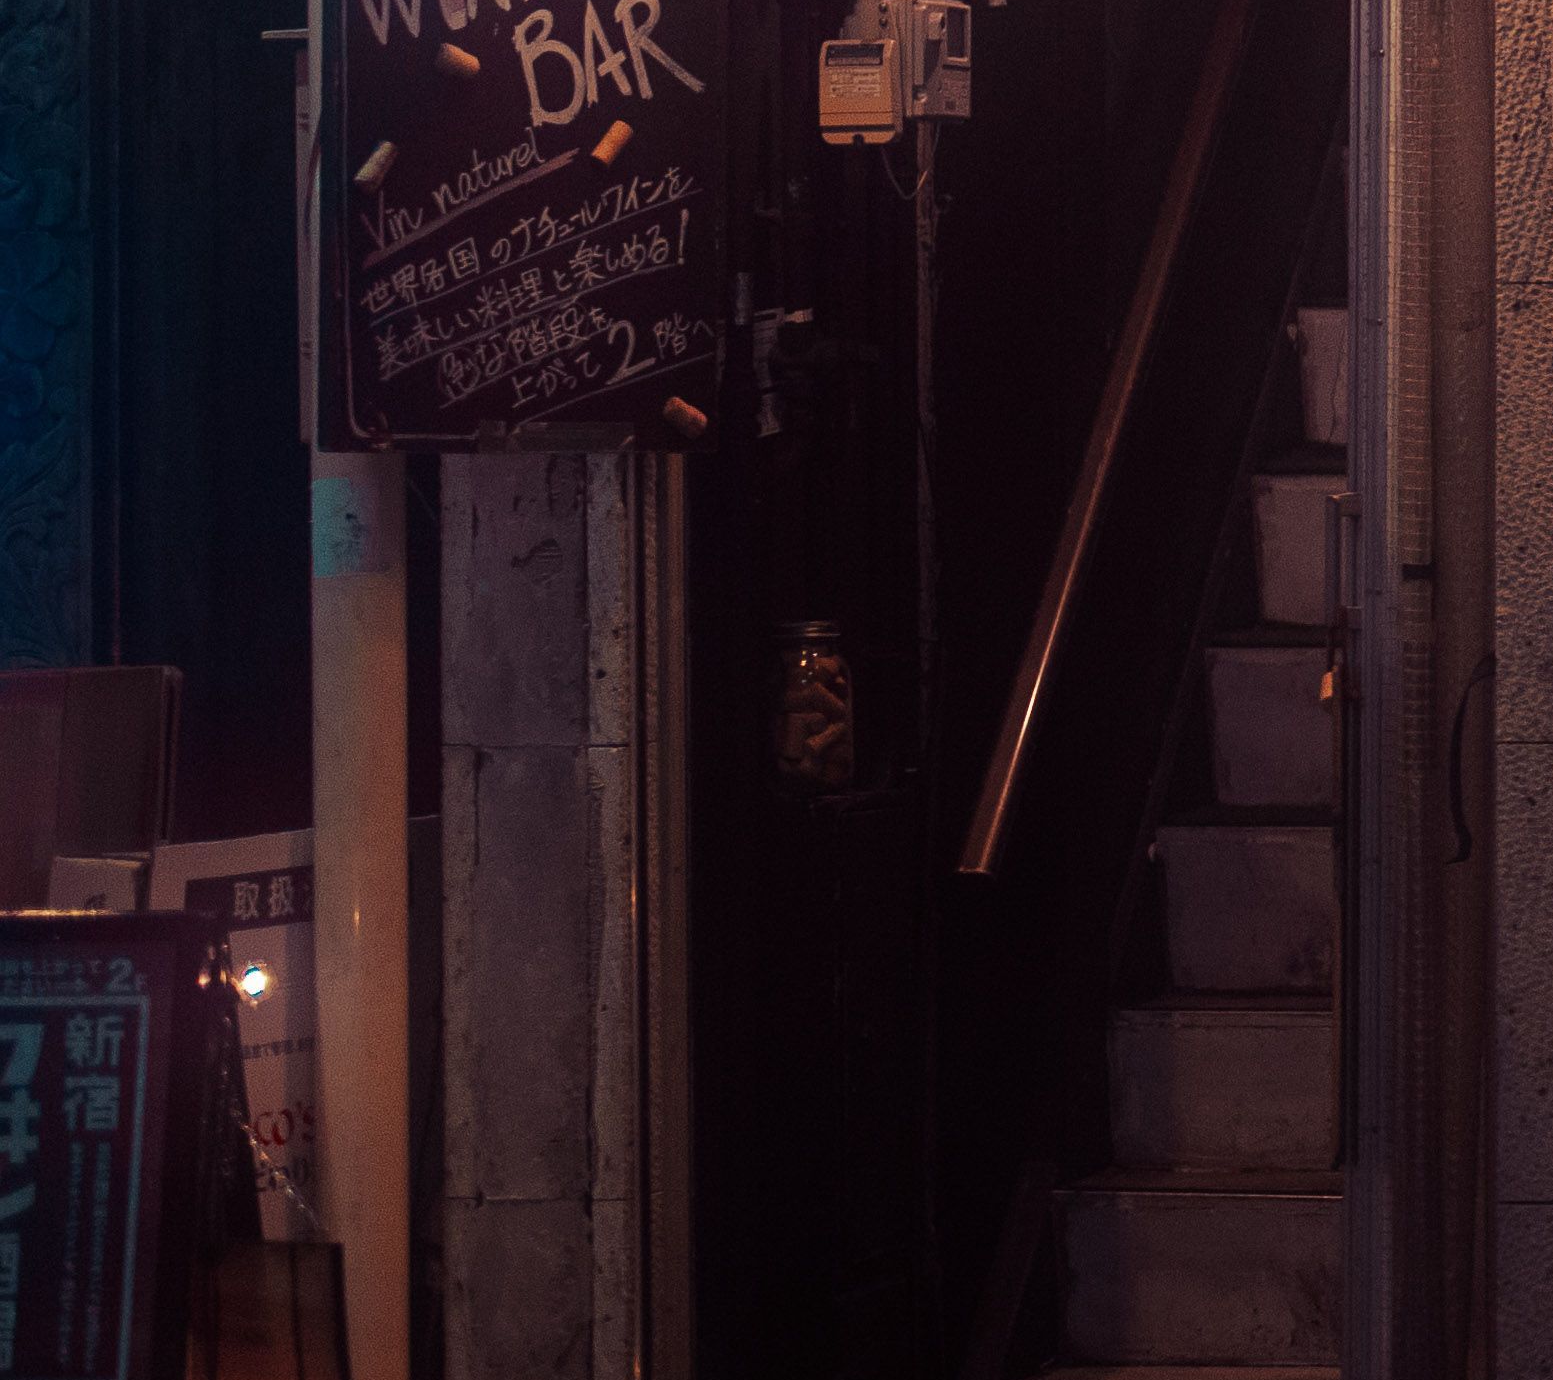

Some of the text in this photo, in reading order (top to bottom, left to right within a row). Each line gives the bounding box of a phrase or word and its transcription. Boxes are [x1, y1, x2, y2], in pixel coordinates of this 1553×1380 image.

[360, 125, 546, 251] Vin naturel
[63, 1013, 126, 1131] 新宿
